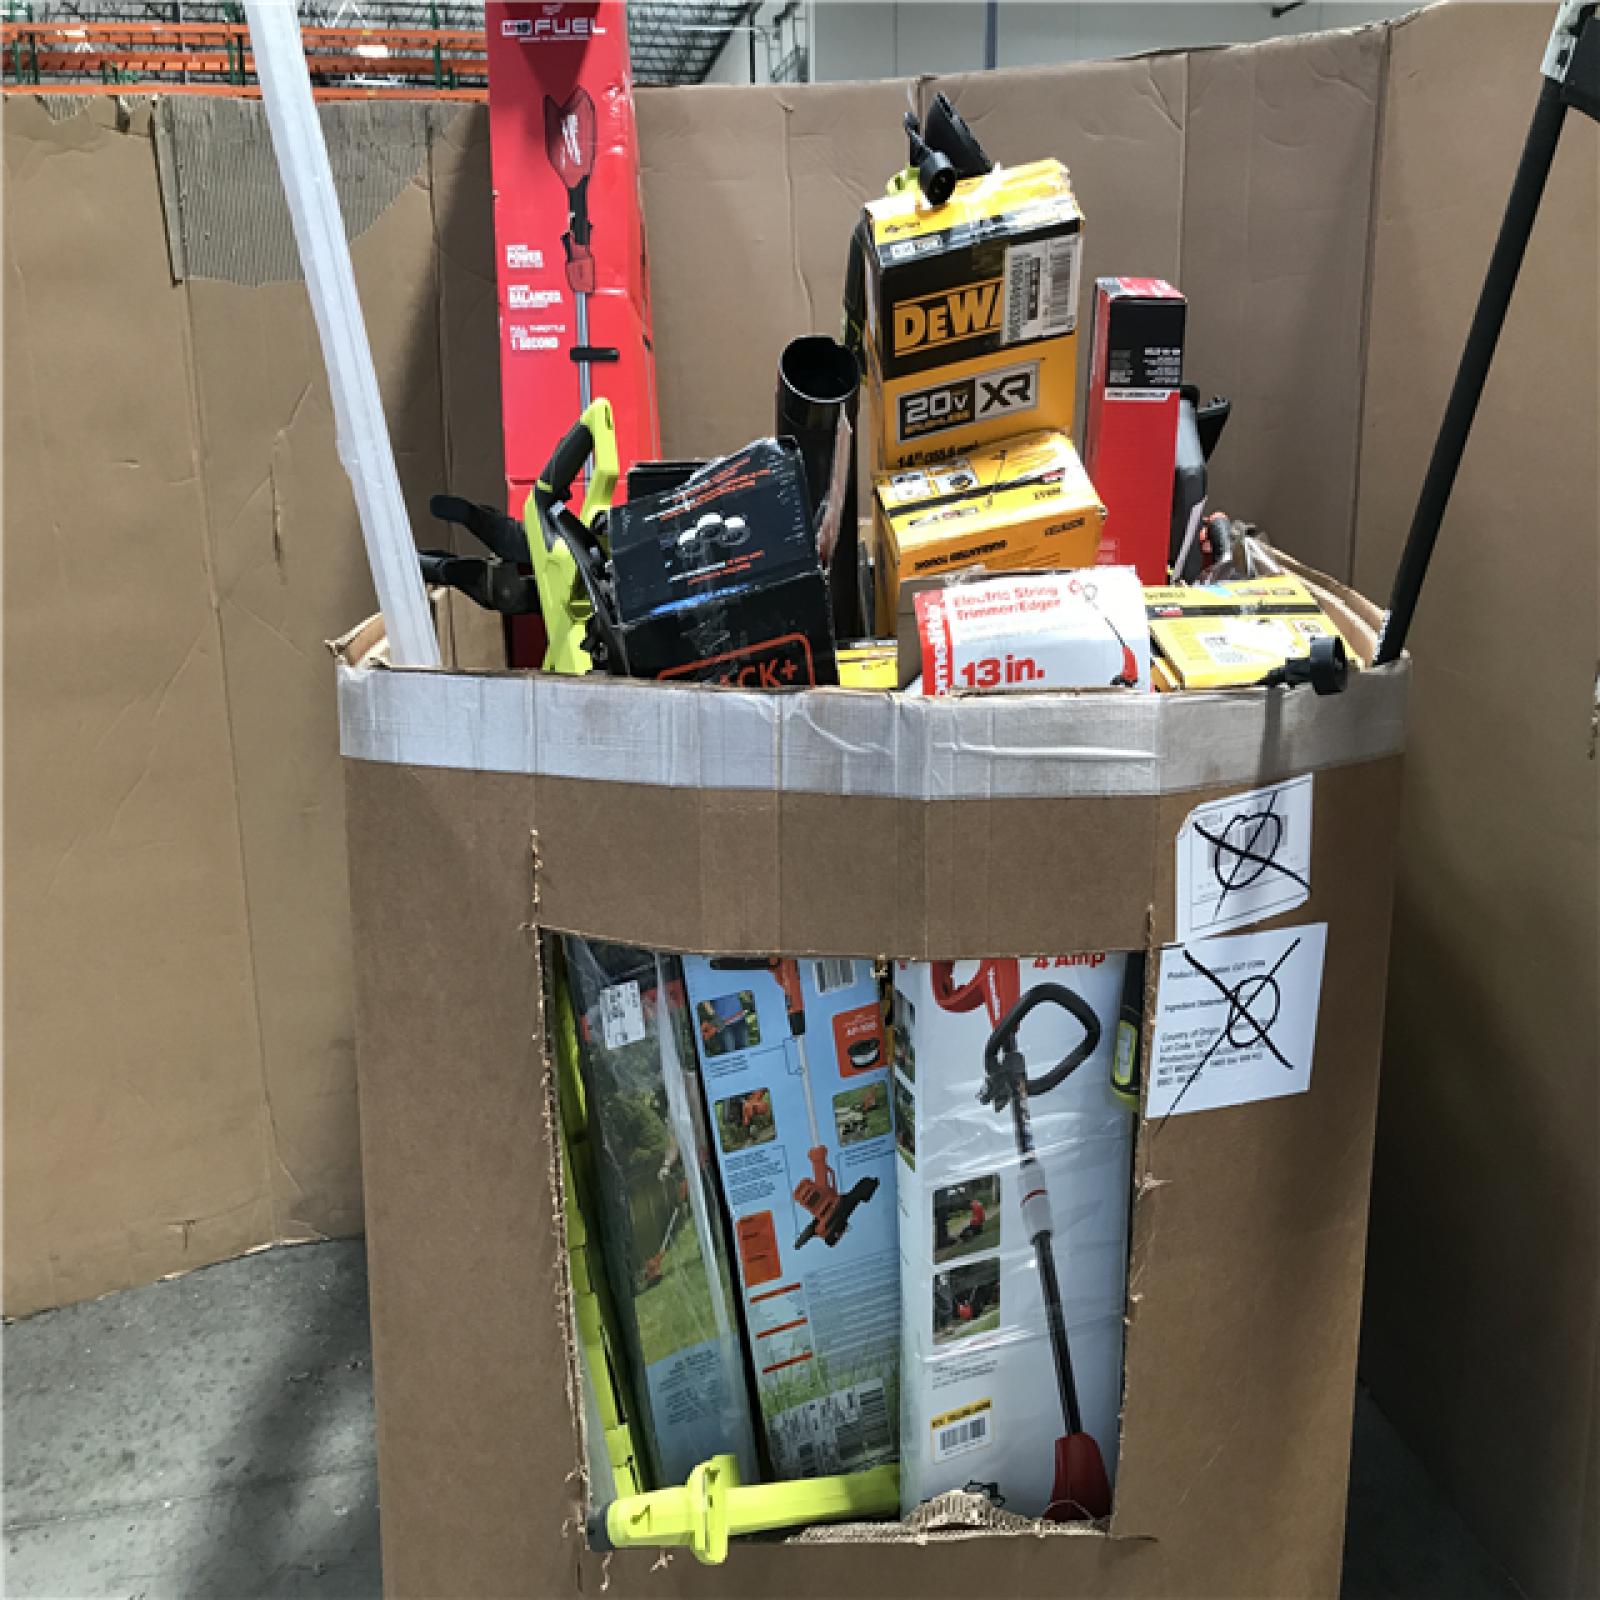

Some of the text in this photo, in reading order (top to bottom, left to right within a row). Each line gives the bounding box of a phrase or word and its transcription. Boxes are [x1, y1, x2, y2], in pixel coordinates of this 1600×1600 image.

[535, 17, 606, 35] FUEL
[980, 372, 1031, 413] XR
[954, 585, 1058, 607] Electric String
[961, 654, 1046, 687] 13 in.
